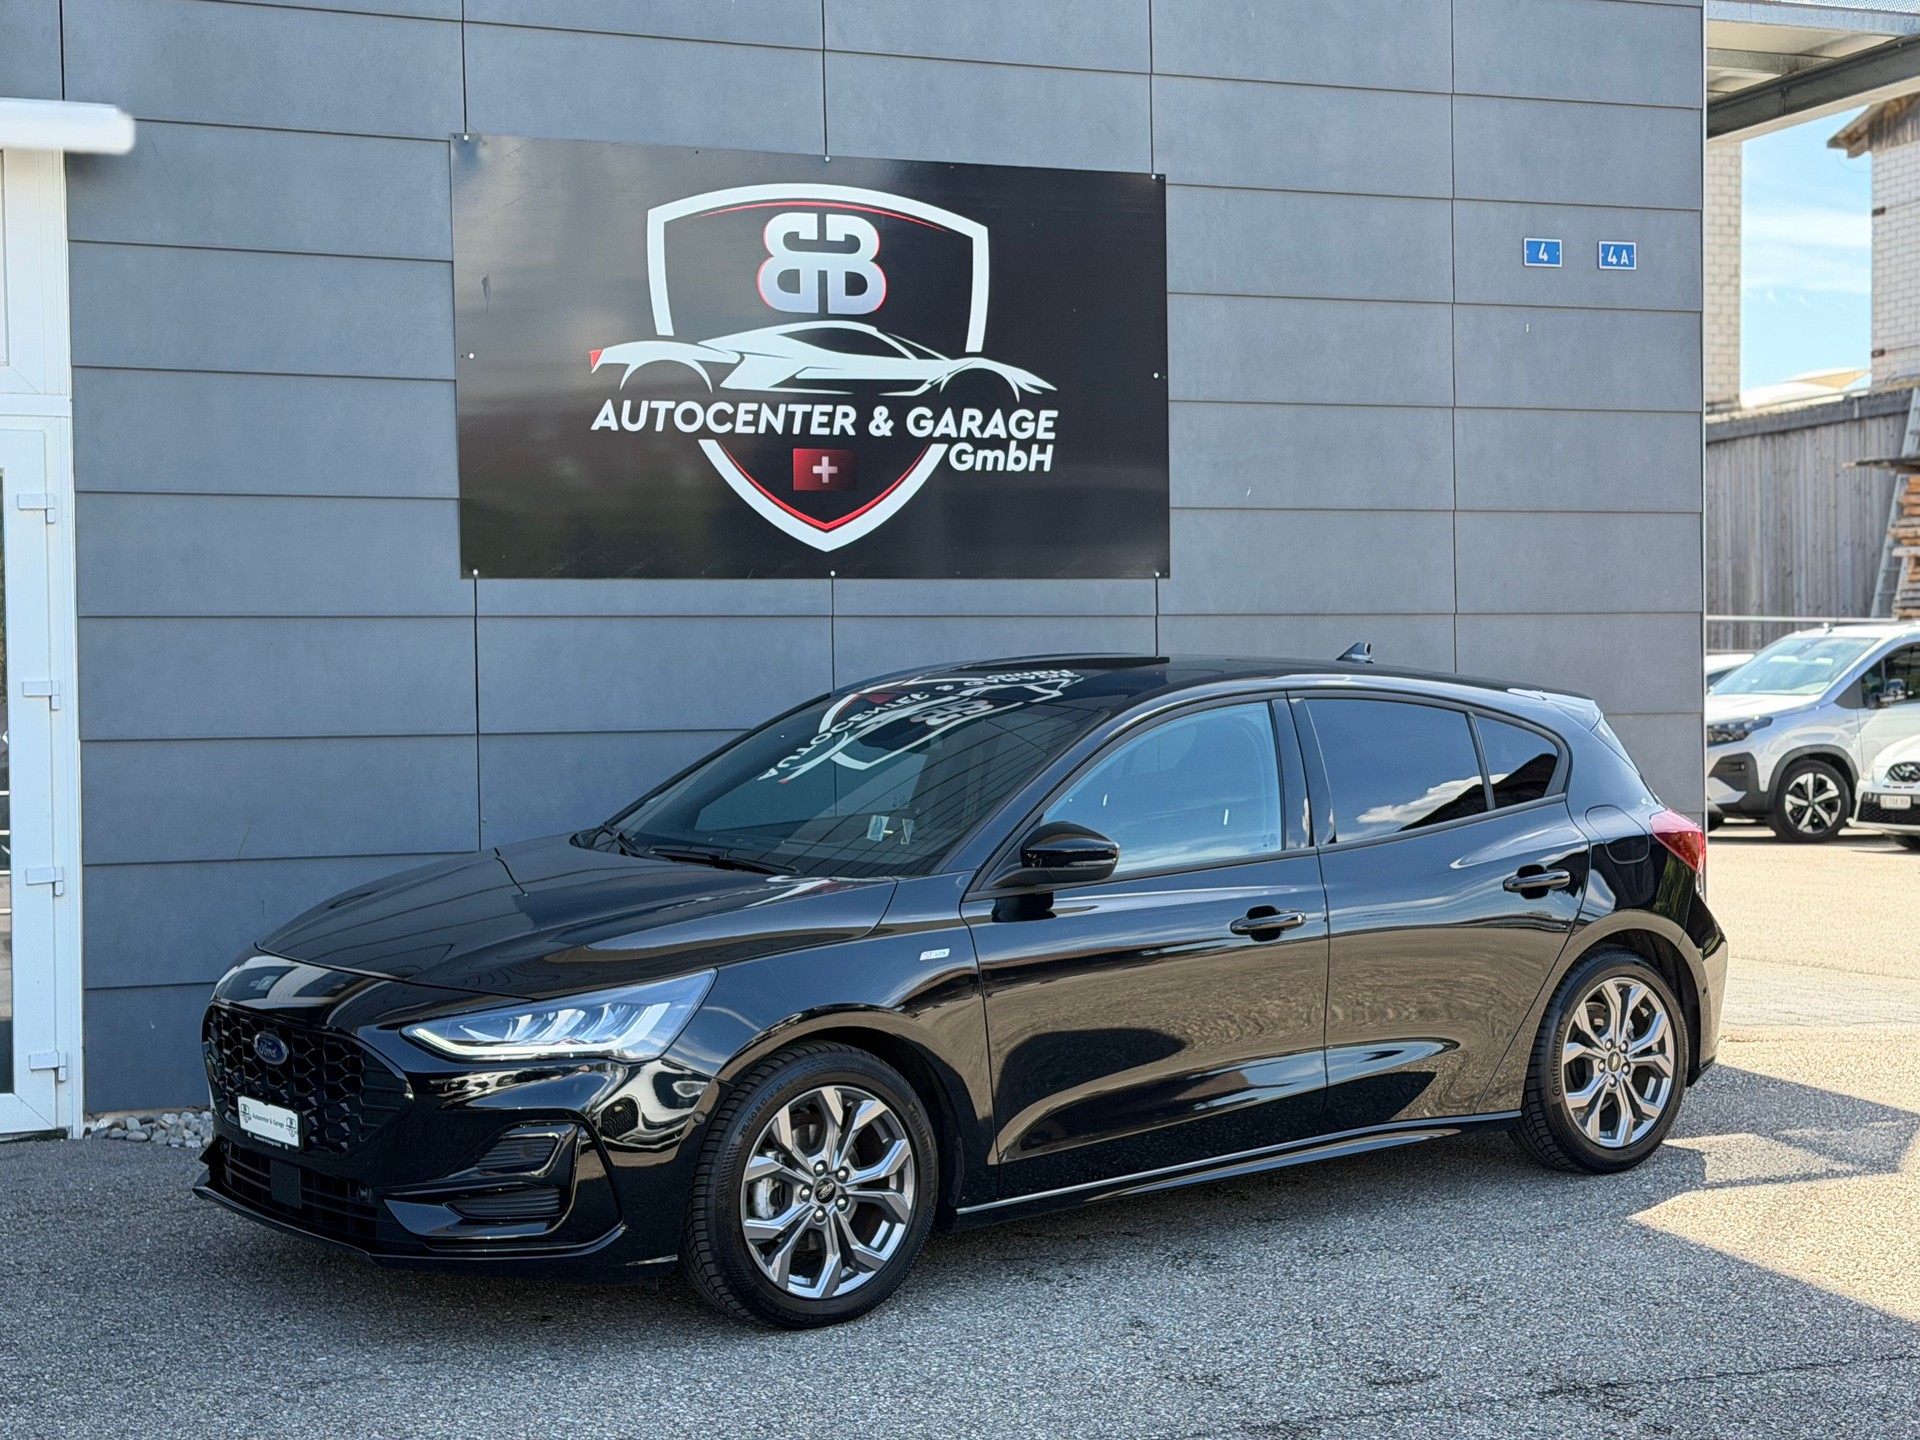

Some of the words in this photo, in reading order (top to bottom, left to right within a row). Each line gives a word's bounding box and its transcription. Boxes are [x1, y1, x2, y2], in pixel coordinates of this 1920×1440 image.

[1538, 243, 1549, 262] 4
[1607, 246, 1629, 265] 4A
[591, 398, 857, 437] AUTOCENTER
[868, 406, 894, 438] &
[906, 407, 1059, 440] GARAGE
[948, 441, 1054, 473] GmbH
[259, 1039, 277, 1059] Ford
[1551, 1030, 1564, 1096] Continental
